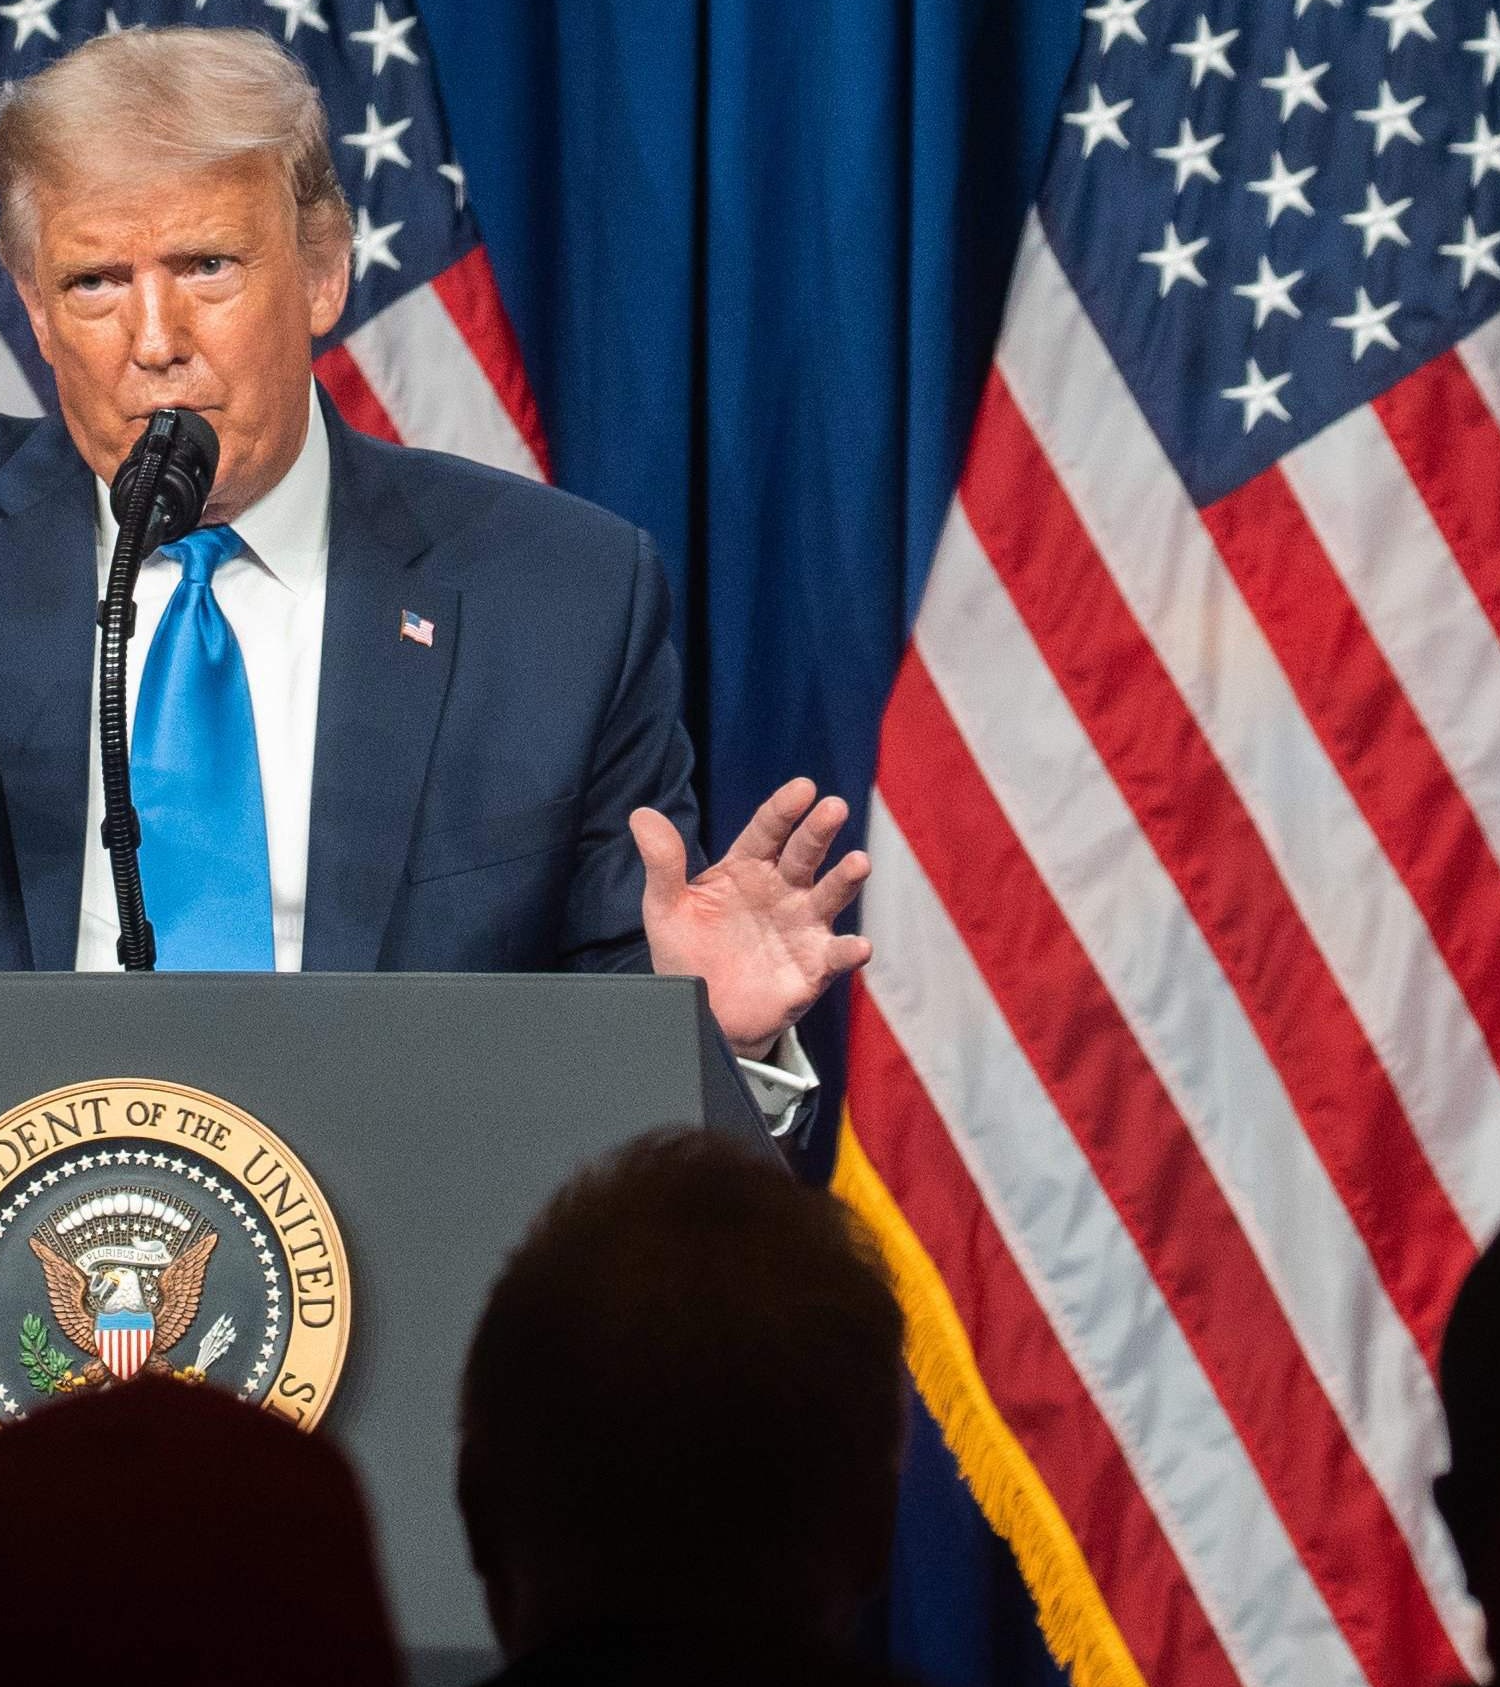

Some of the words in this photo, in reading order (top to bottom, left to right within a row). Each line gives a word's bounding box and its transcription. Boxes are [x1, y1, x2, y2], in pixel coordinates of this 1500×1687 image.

[86, 1248, 135, 1261] PLURIBUS
[136, 1252, 167, 1262] UNUM
[125, 1100, 167, 1127] OF
[177, 1108, 232, 1151] THE
[242, 1144, 335, 1329] UNITED
